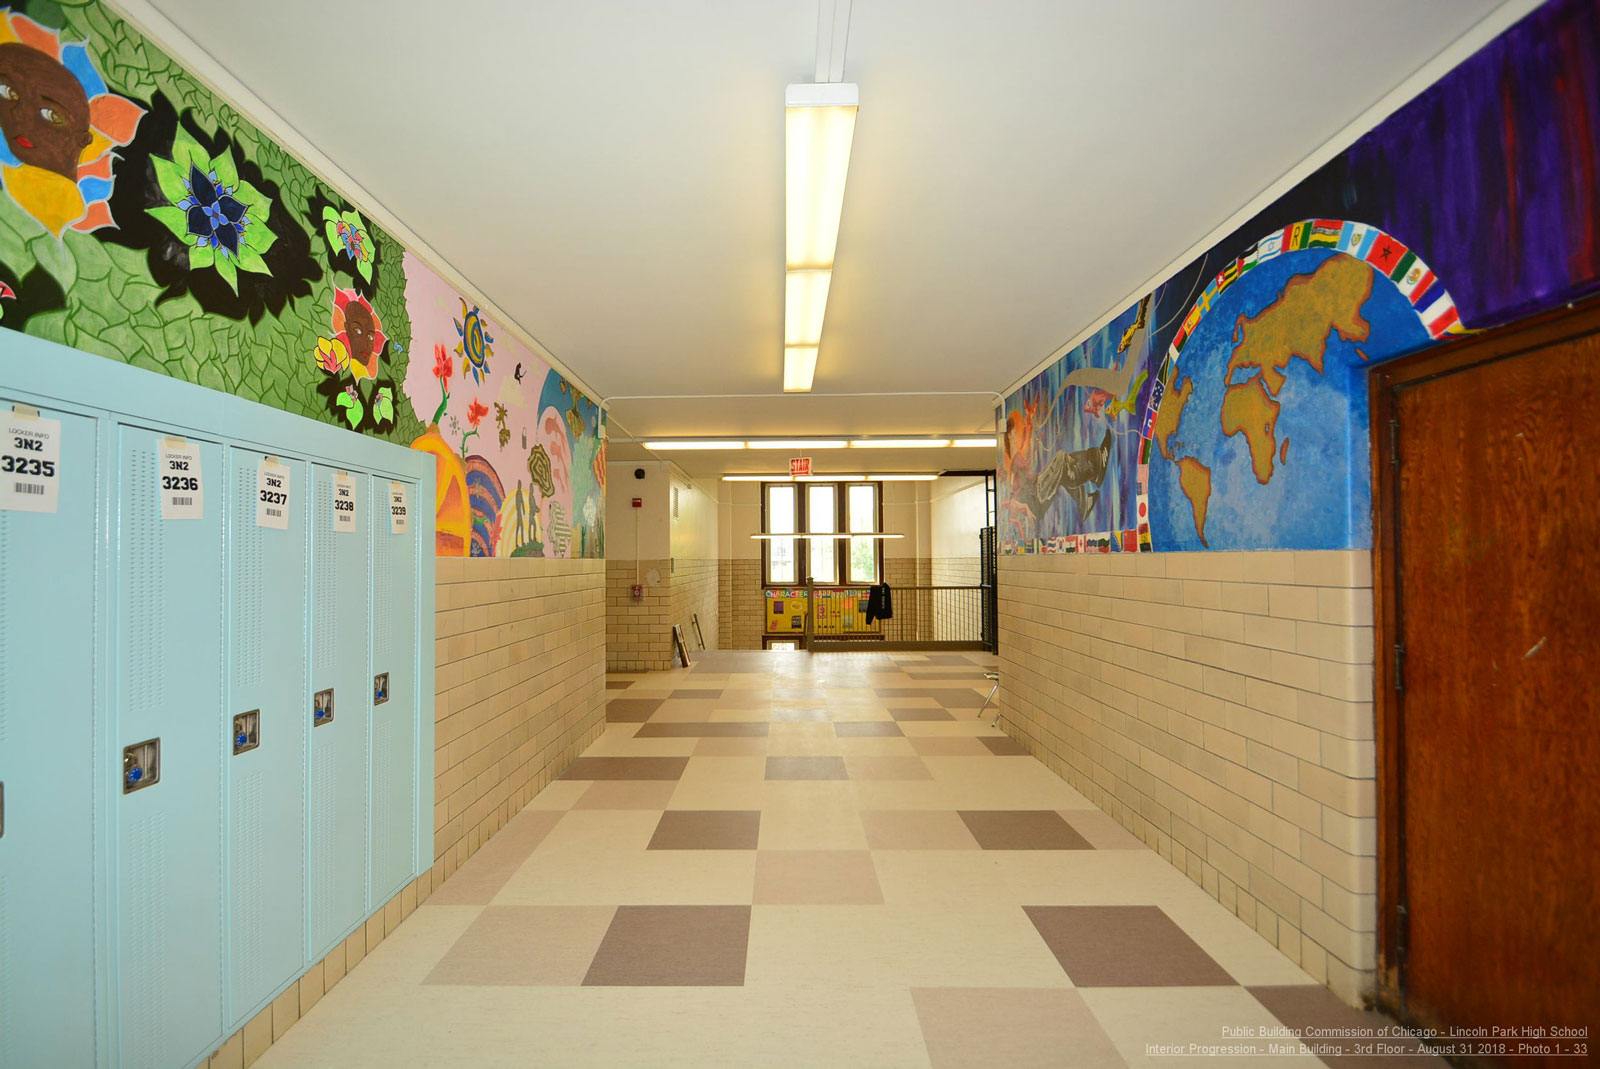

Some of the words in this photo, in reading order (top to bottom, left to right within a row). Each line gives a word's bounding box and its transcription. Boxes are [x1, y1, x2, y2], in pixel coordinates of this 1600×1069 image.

[9, 427, 33, 437] LOCKER
[14, 437, 43, 452] 3N2
[1, 455, 55, 477] 3235
[169, 460, 189, 471] 3N2
[791, 458, 809, 471] STAIR
[162, 476, 199, 491] 3236
[266, 478, 282, 488] 3N2
[260, 489, 287, 505] 3237
[338, 488, 350, 497] 3N2
[334, 499, 354, 511] 3238
[391, 506, 406, 515] 3239
